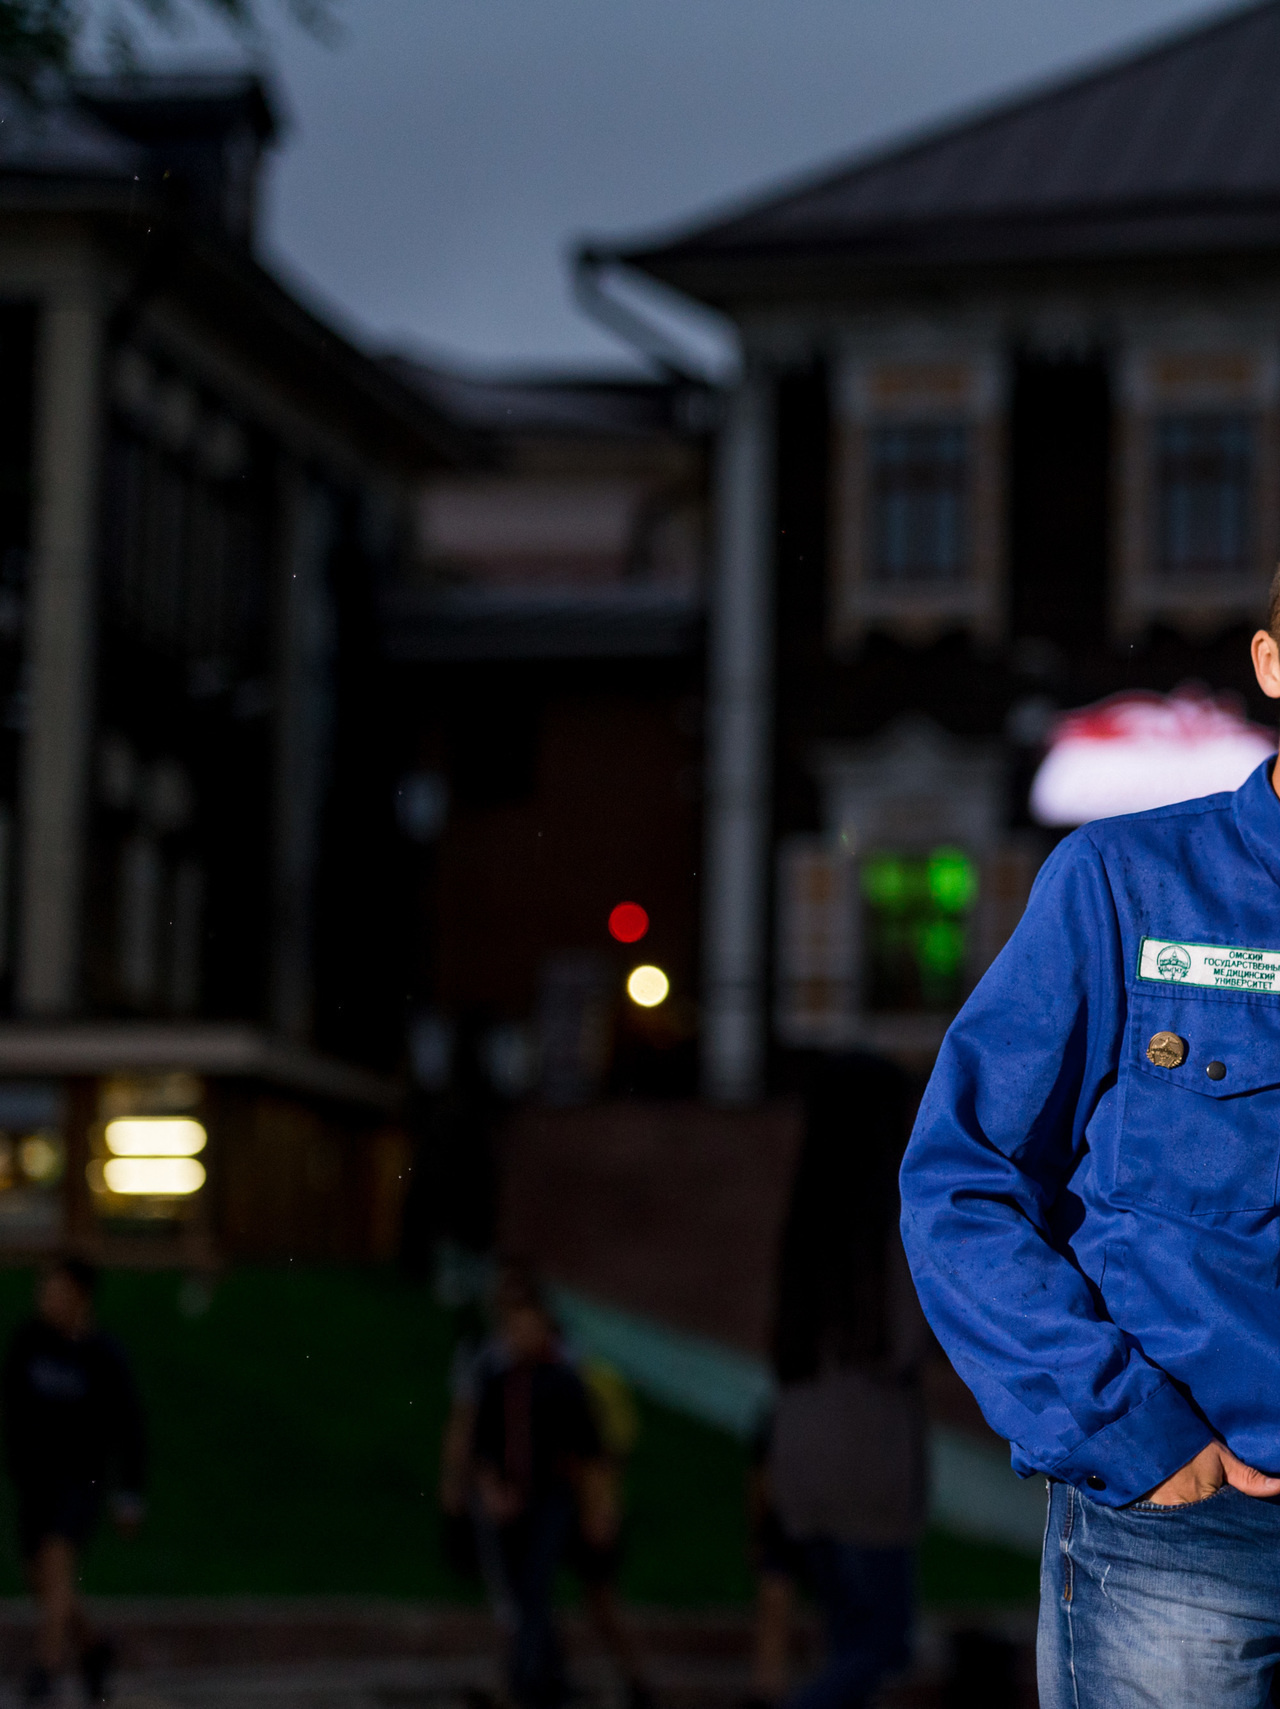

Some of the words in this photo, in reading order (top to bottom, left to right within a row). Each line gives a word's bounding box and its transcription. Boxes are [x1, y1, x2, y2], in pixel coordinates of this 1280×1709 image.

[1229, 951, 1263, 961] ОМСКИЙ
[1213, 968, 1275, 981] МЕДИЦИНСКИЙ
[1215, 977, 1273, 989] УНИВЕРСИТЕТ
